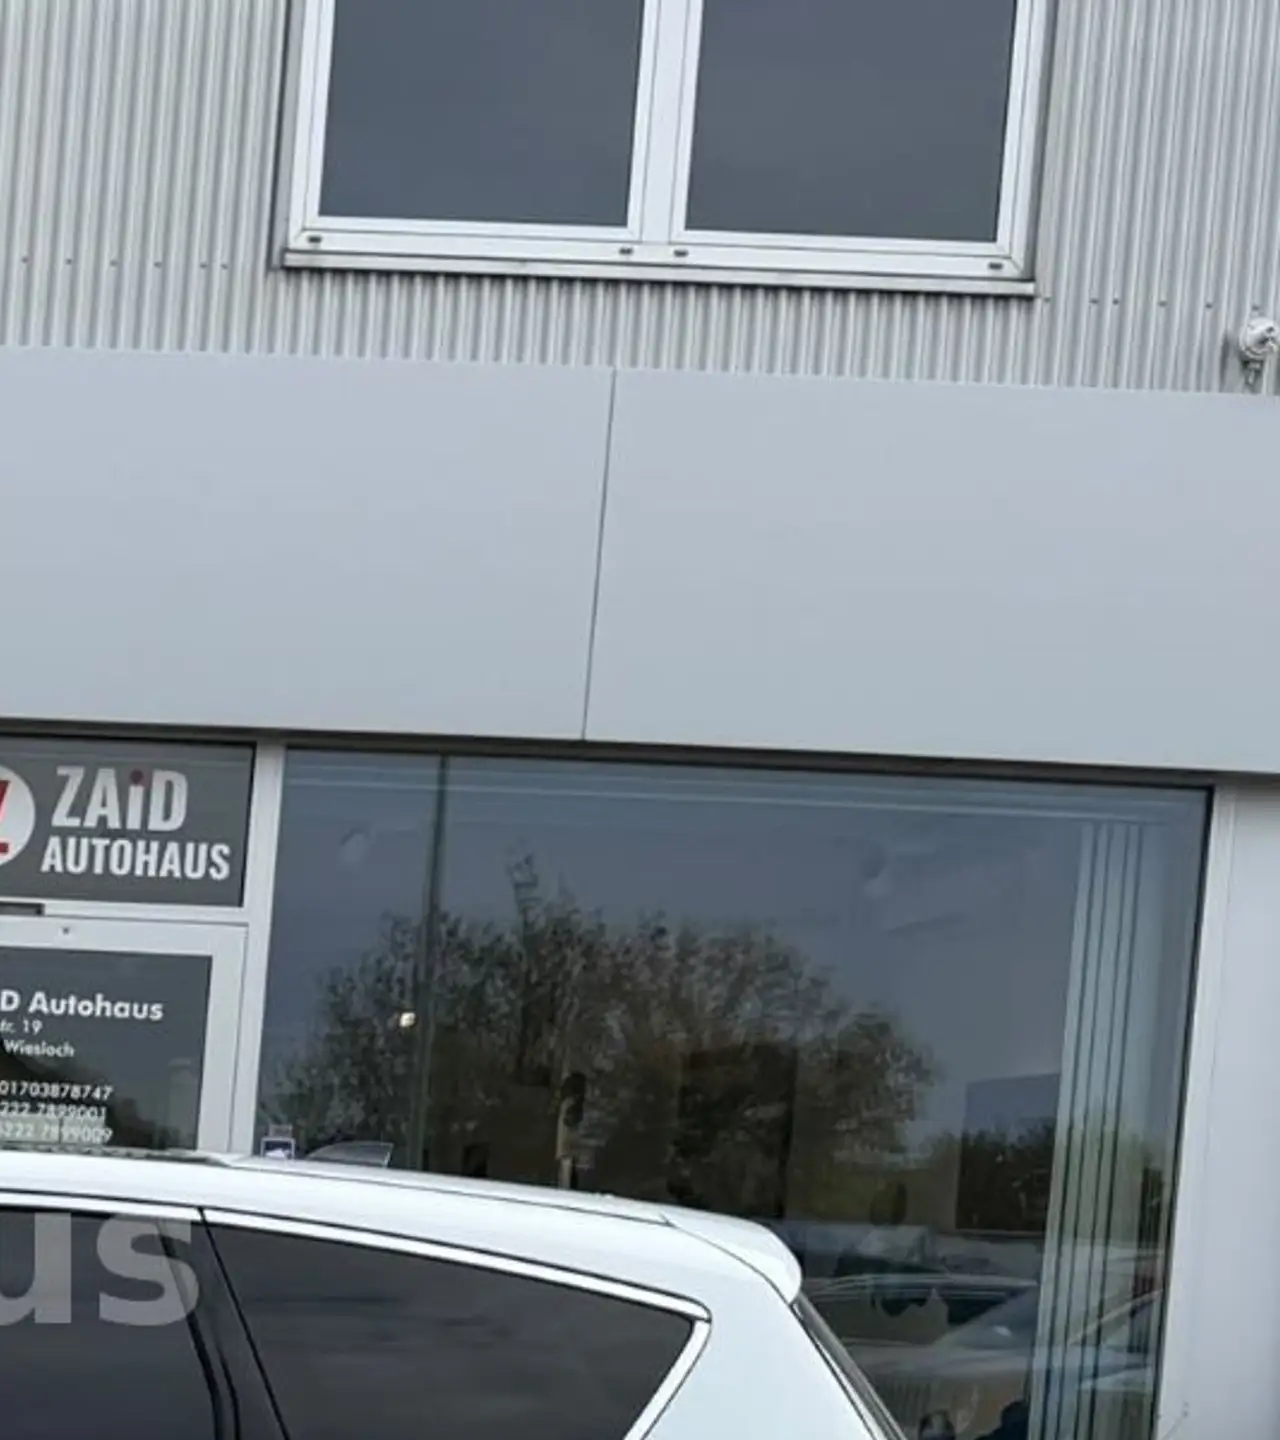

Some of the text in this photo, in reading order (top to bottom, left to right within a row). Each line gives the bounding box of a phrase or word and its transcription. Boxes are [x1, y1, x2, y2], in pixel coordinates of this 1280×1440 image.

[50, 765, 189, 832] ZAiD
[40, 836, 232, 881] AUTOHAUS
[28, 990, 165, 1022] Autohaus
[22, 1018, 44, 1035] 19
[3, 1037, 77, 1058] Wiesloch
